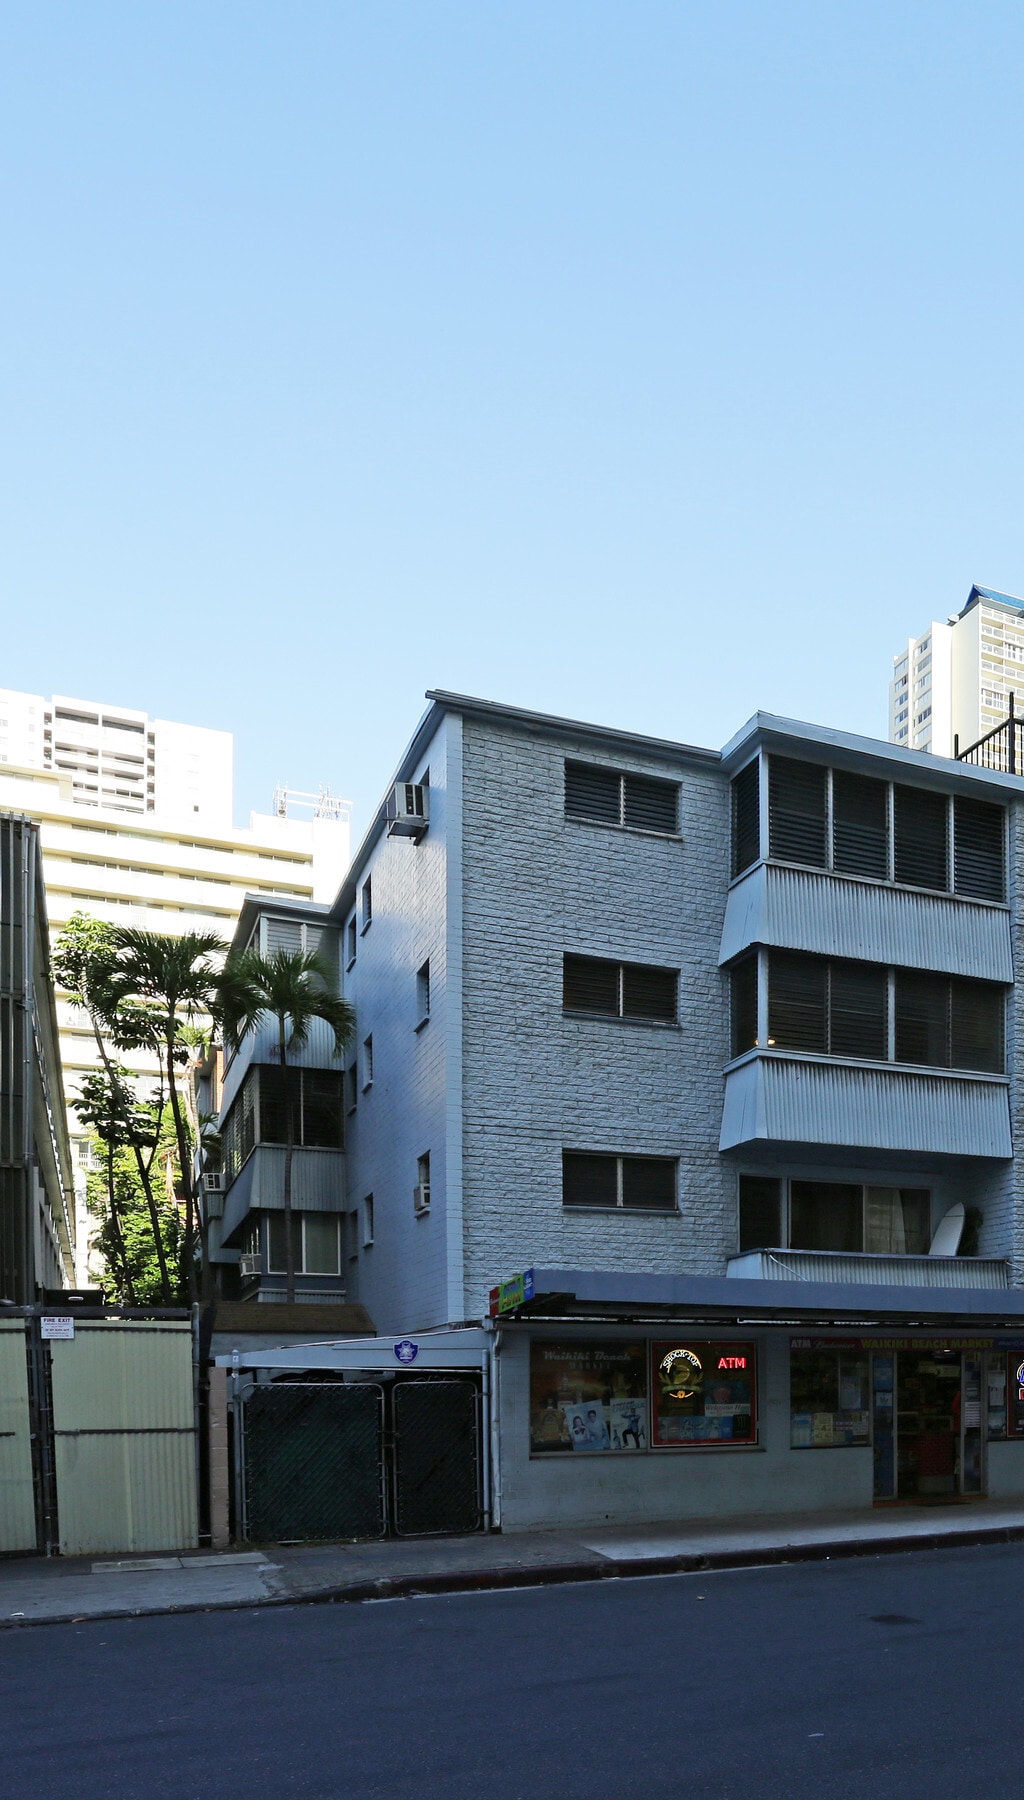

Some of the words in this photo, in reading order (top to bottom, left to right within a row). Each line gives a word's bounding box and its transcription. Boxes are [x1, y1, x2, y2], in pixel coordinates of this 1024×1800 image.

[791, 1339, 811, 1350] ATM
[861, 1339, 908, 1350] WAIKIKI
[911, 1339, 948, 1349] BEACH
[950, 1339, 994, 1349] MARKET
[543, 1351, 591, 1361] Waikiki
[593, 1351, 632, 1361] Beach
[718, 1357, 748, 1370] ATM
